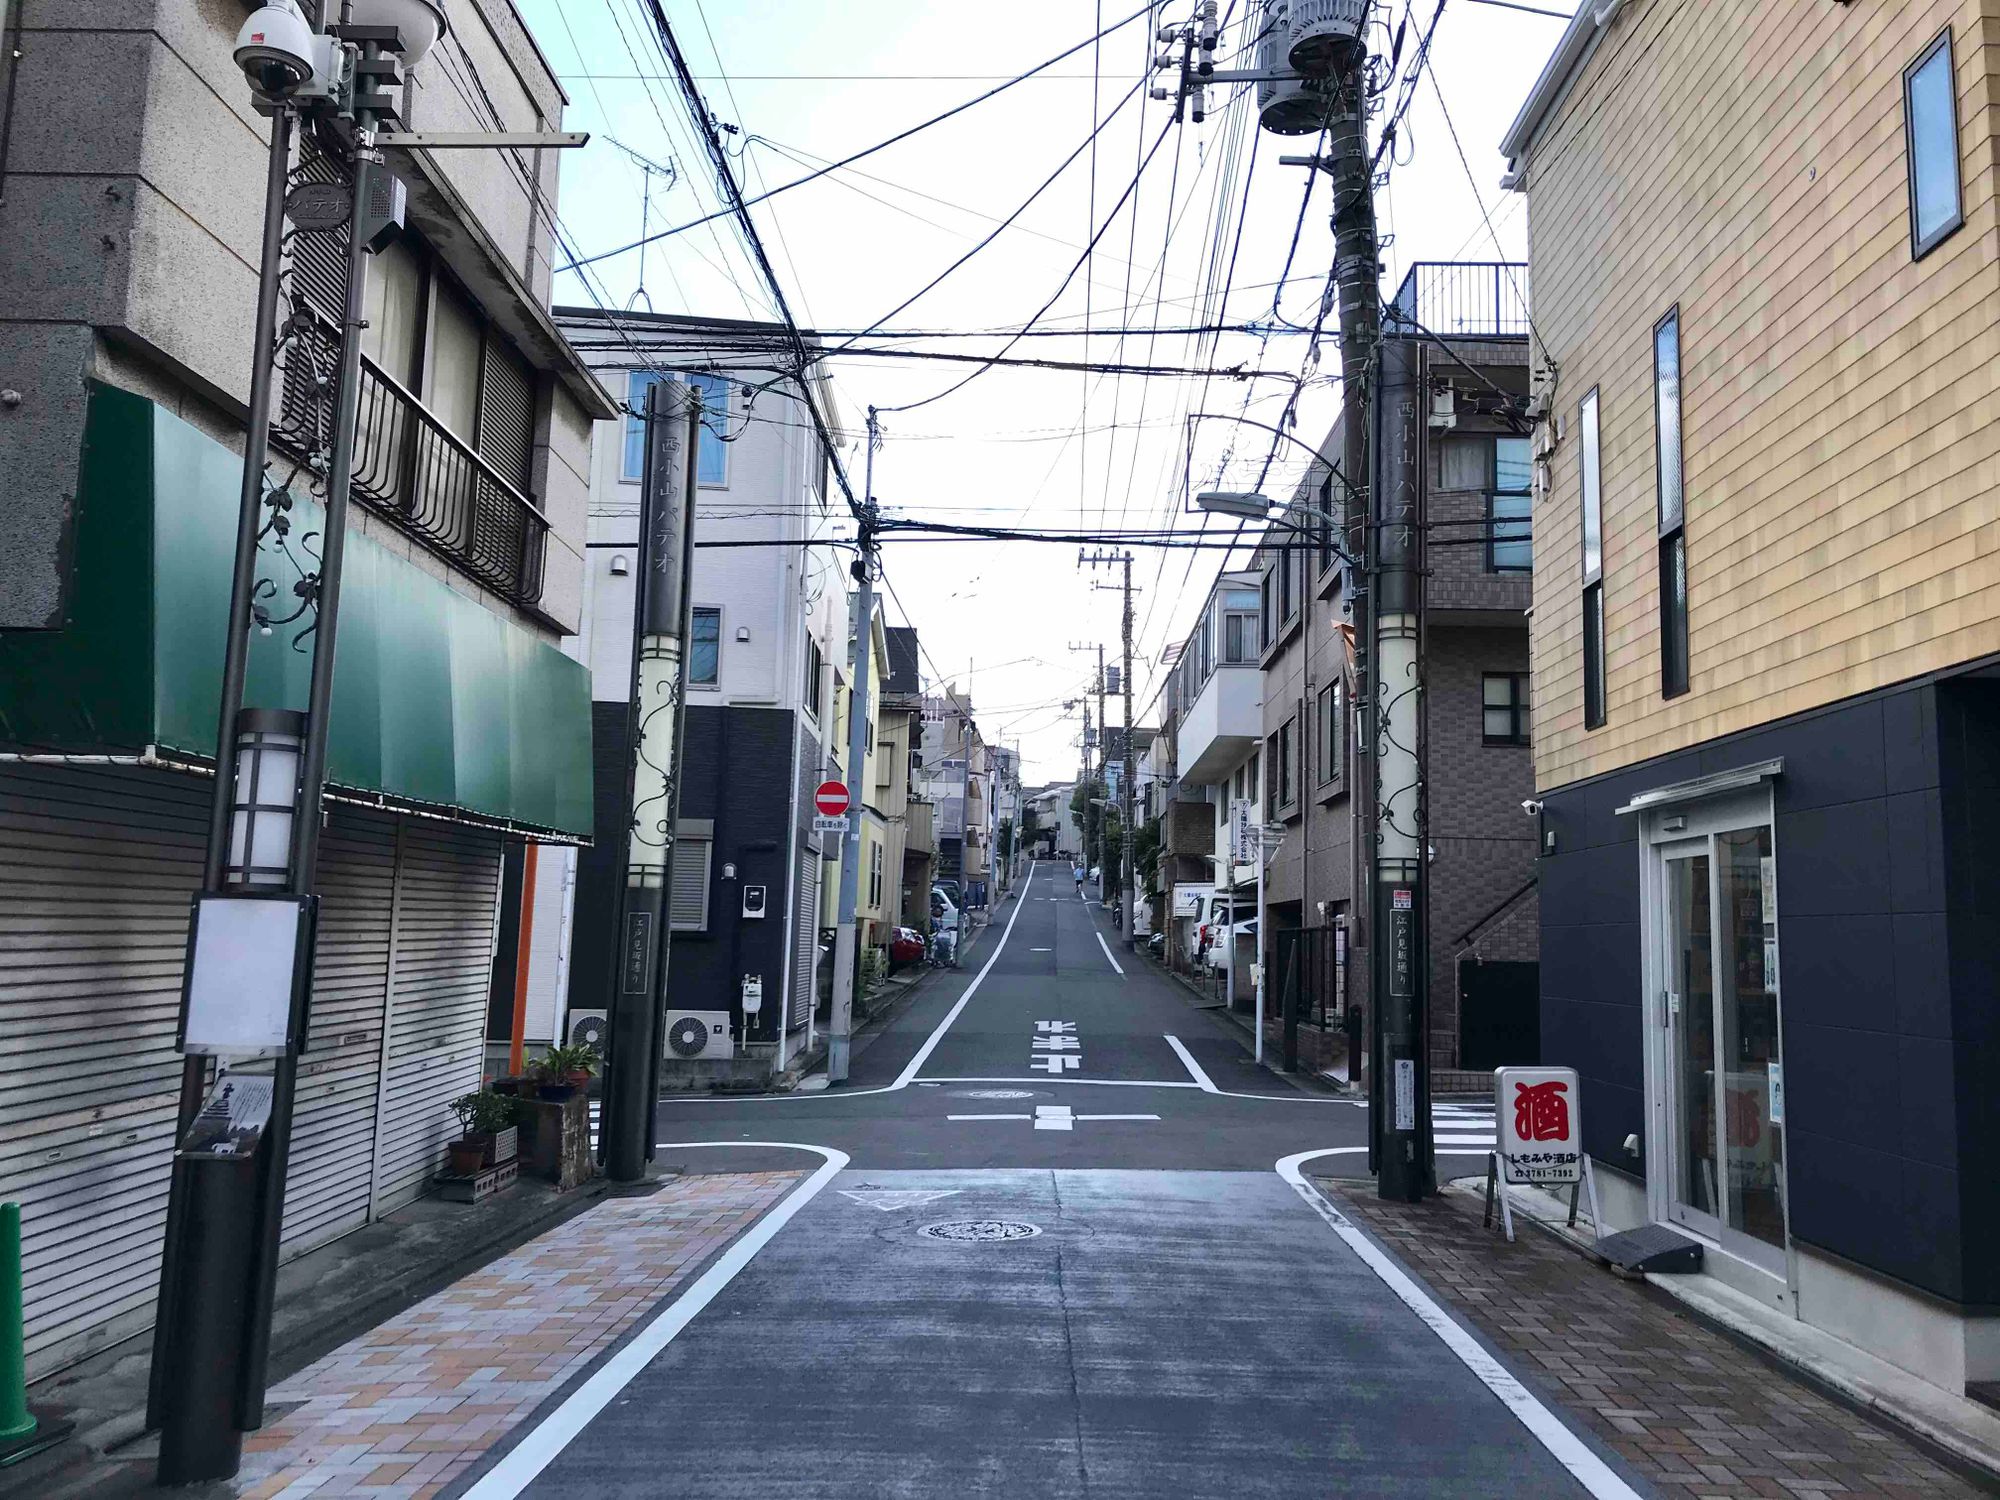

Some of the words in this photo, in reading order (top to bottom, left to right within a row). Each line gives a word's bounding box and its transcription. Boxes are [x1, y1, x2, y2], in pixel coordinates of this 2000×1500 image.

[655, 436, 681, 574] 西小山パテオ
[815, 820, 848, 829] 自転車を除く
[1396, 915, 1408, 984] 江戸見坂通り
[1514, 1081, 1570, 1141] 酒
[1511, 1152, 1577, 1164] しもみや酒店
